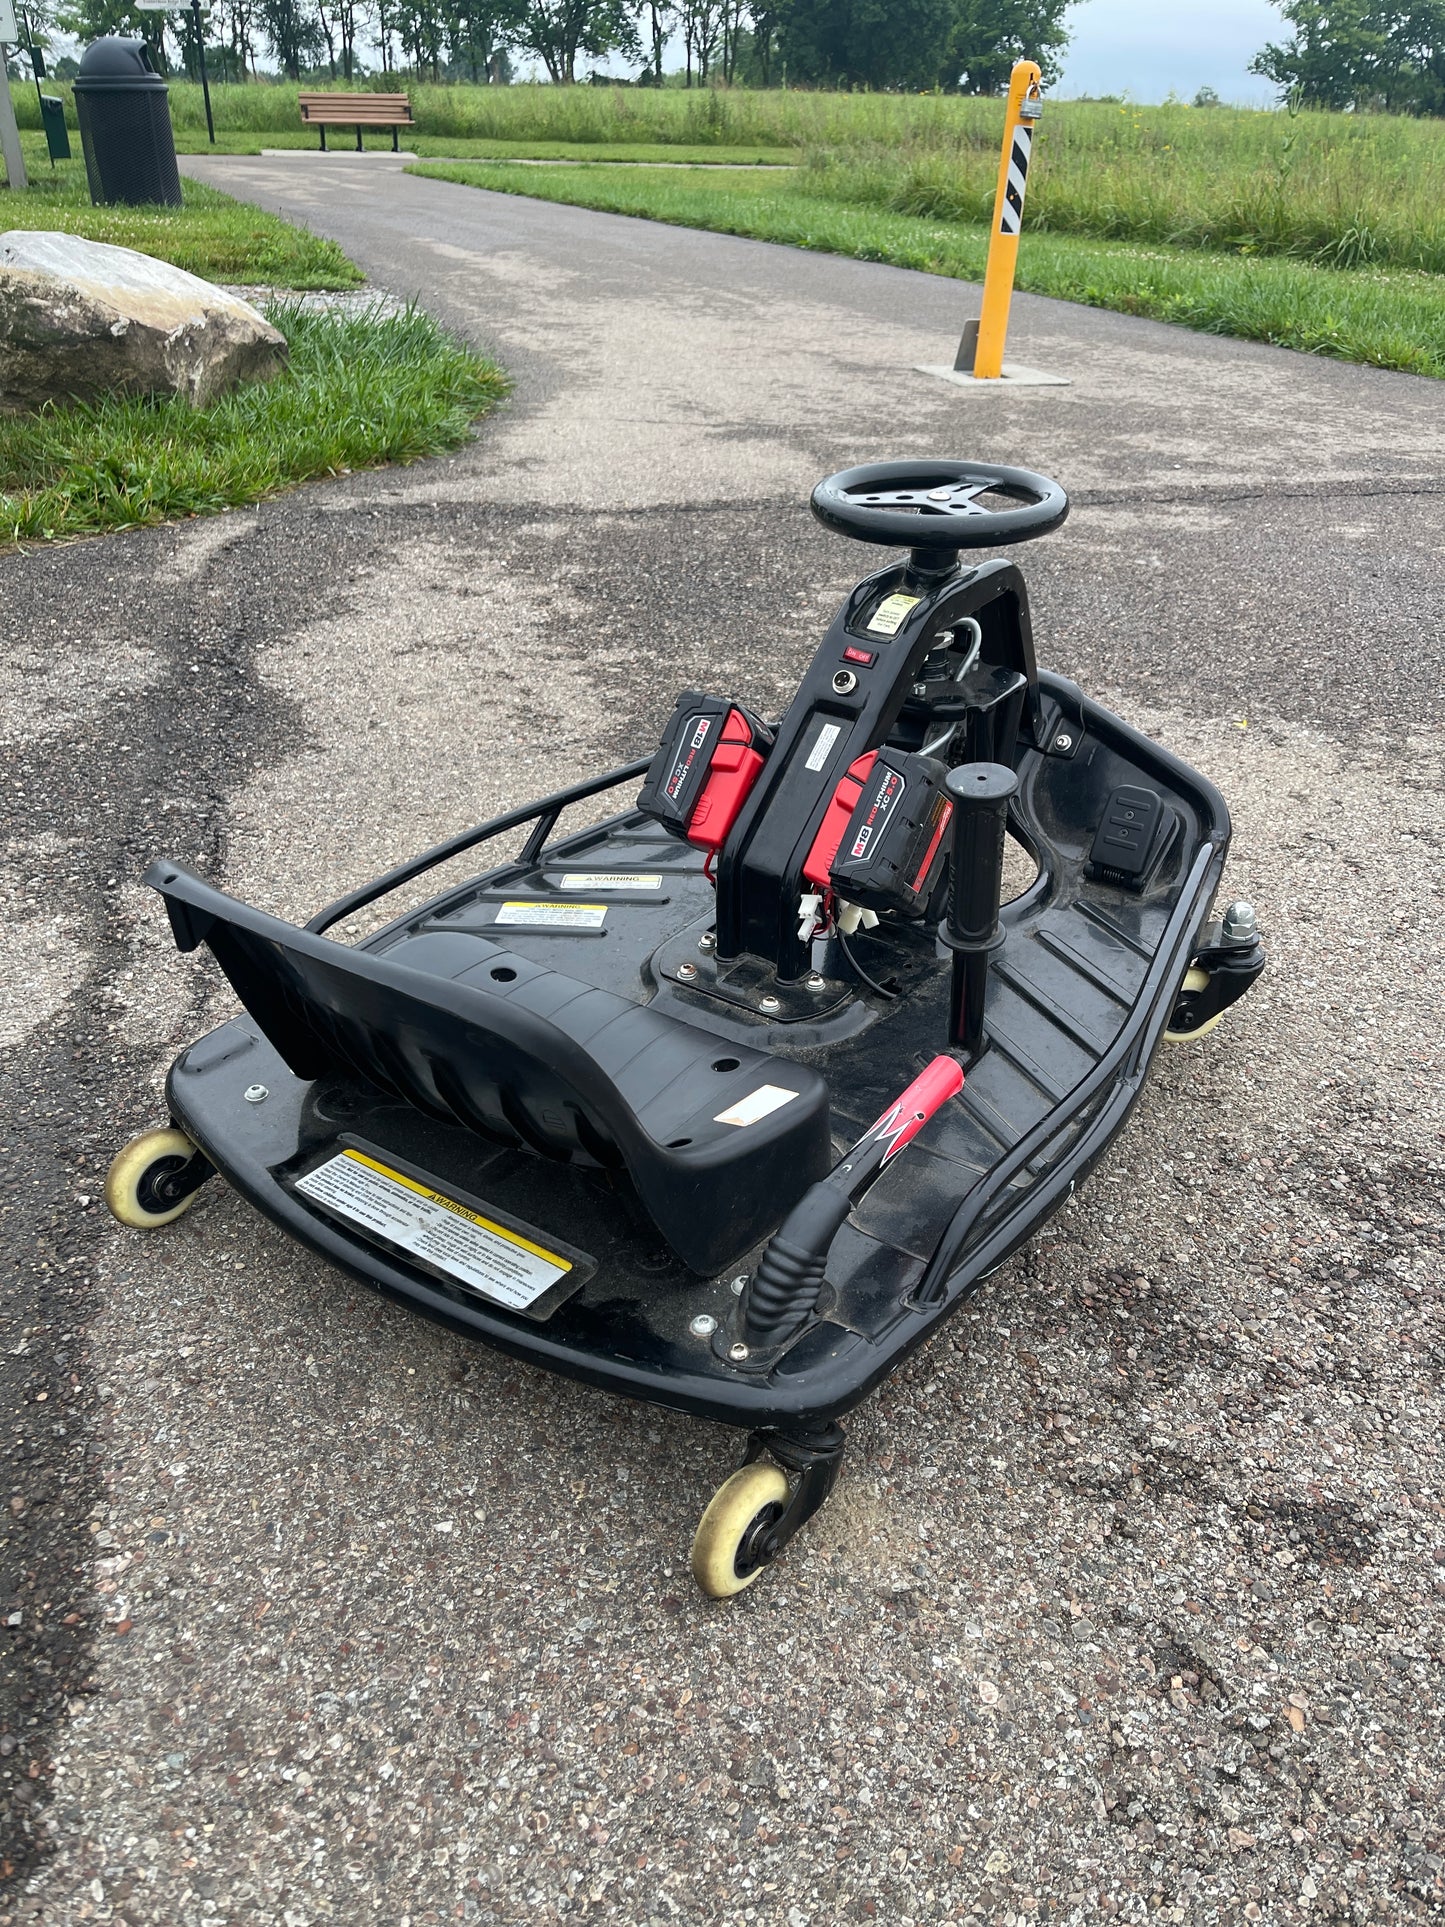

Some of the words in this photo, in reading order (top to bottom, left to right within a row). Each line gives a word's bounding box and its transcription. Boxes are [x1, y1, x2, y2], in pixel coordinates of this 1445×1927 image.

[693, 721, 709, 747] M18
[672, 749, 697, 799] REDLITHIUM
[866, 771, 892, 826] REDLITHIUM
[853, 828, 869, 855] M18
[434, 1195, 478, 1221] WARNING
